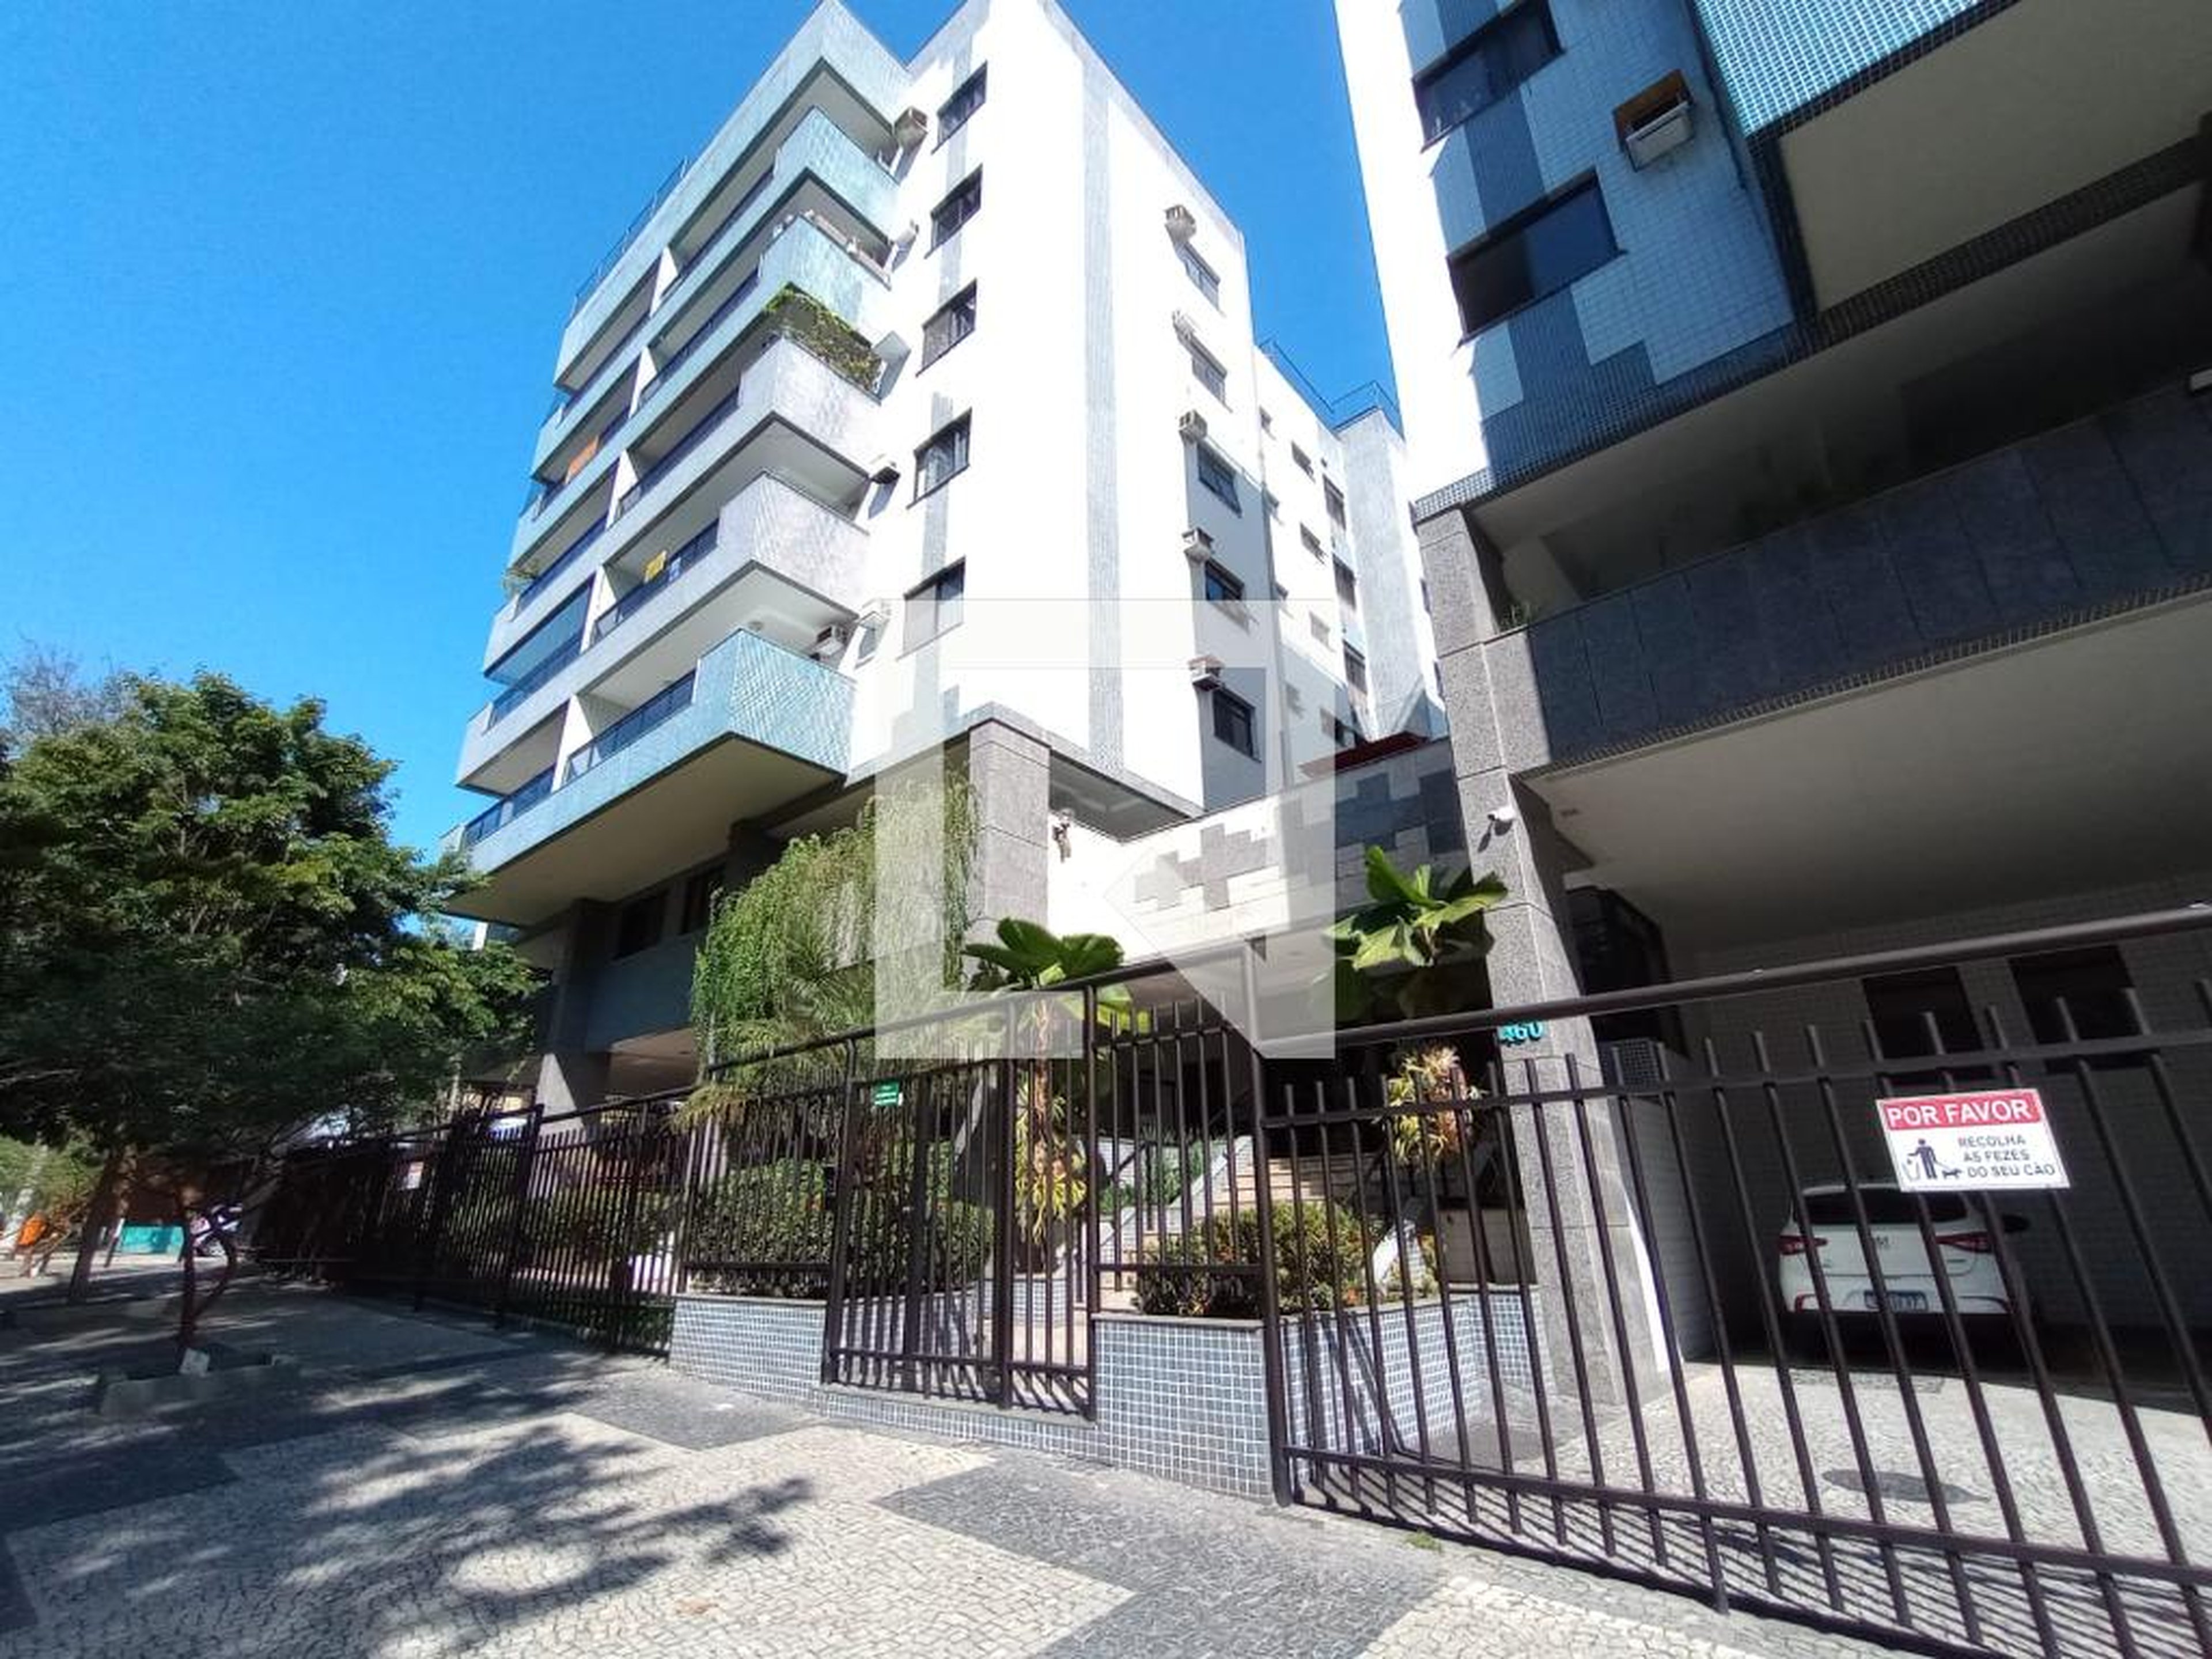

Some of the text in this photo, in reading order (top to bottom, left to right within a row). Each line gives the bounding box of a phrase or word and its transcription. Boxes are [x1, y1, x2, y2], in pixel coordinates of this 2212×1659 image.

[1887, 1099, 2032, 1127] POR FAVOR
[1958, 1135, 2026, 1147] RECOLHA
[1964, 1149, 2029, 1162] AS FEZES
[1967, 1162, 2055, 1178] DO SEU CÃO
